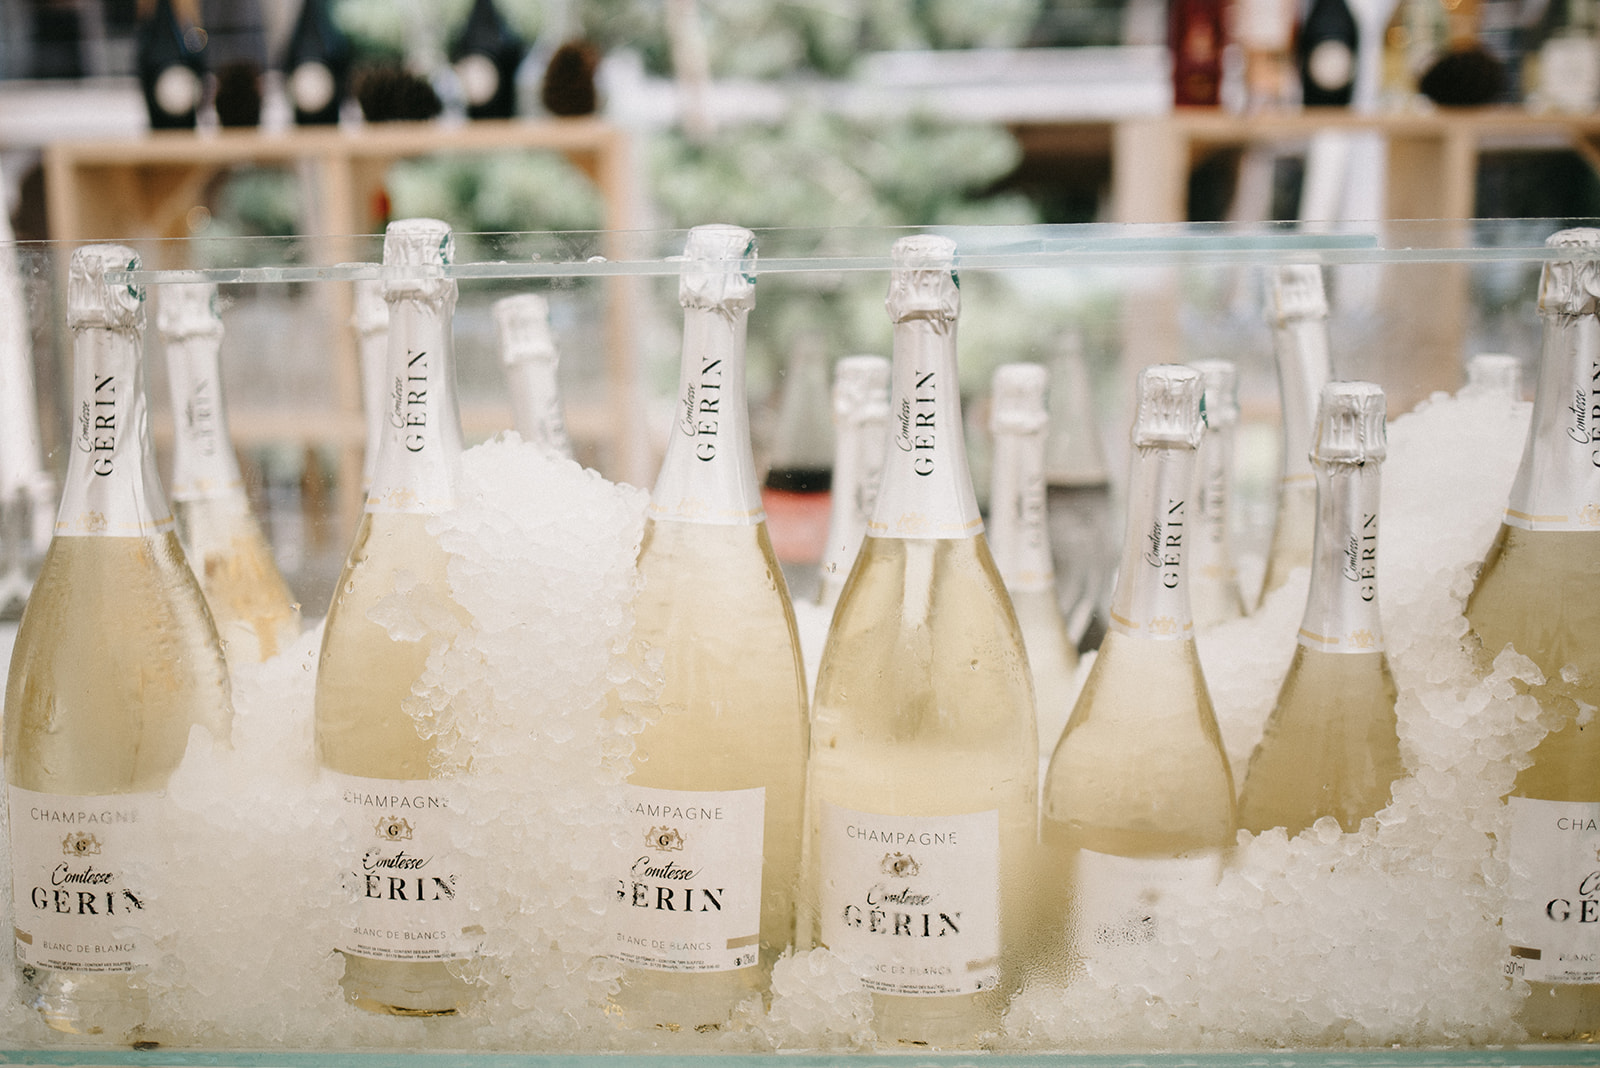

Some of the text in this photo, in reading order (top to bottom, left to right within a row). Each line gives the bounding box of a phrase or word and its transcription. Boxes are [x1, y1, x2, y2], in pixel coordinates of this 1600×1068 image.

[77, 400, 93, 453] Comtesse
[391, 375, 404, 429] Comtesse
[680, 380, 696, 437] Comtesse
[895, 395, 912, 452] Comtesse
[1566, 384, 1590, 445] Comtesse
[1144, 517, 1163, 568] Comtesse
[1342, 533, 1360, 582] Comtesse
[846, 825, 958, 846] CHAMPAGNE
[51, 861, 117, 886] Comtesse
[43, 941, 73, 953] BLANC
[77, 944, 90, 953] DE
[386, 930, 400, 940] DE
[404, 930, 447, 941] BLANCS
